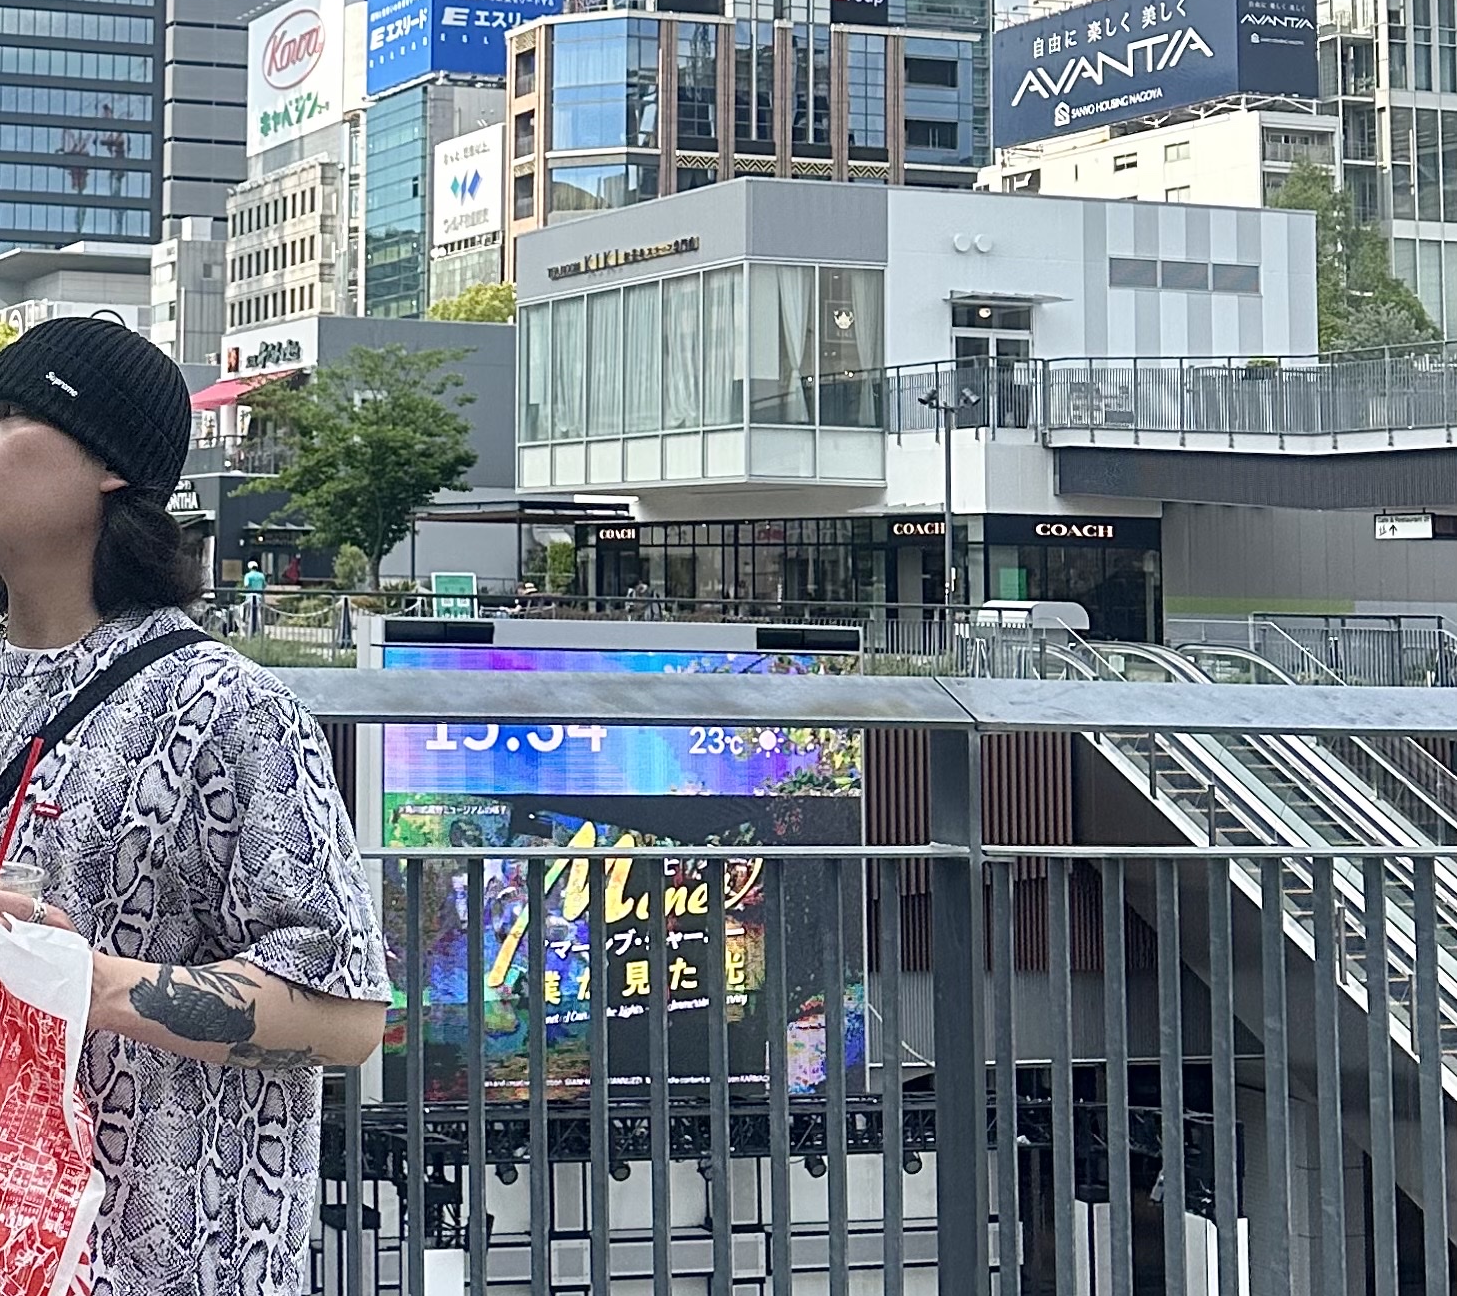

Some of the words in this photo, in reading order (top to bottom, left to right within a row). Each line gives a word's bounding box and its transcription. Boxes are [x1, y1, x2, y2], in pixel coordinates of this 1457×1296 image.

[386, 7, 428, 42] エスリード
[474, 9, 535, 29] エスリー
[1240, 13, 1315, 30] AVANTIA
[1033, 29, 1078, 59] 自由に
[1087, 12, 1130, 44] 楽しく
[1011, 26, 1214, 107] AVANTIA
[1096, 96, 1129, 113] HOUSING
[1129, 87, 1163, 105] NAGOYA
[259, 91, 320, 137] キャベジン
[584, 248, 620, 272] KIKI
[599, 528, 636, 539] COACH
[893, 523, 946, 535] COACH
[1035, 523, 1114, 538] COACH
